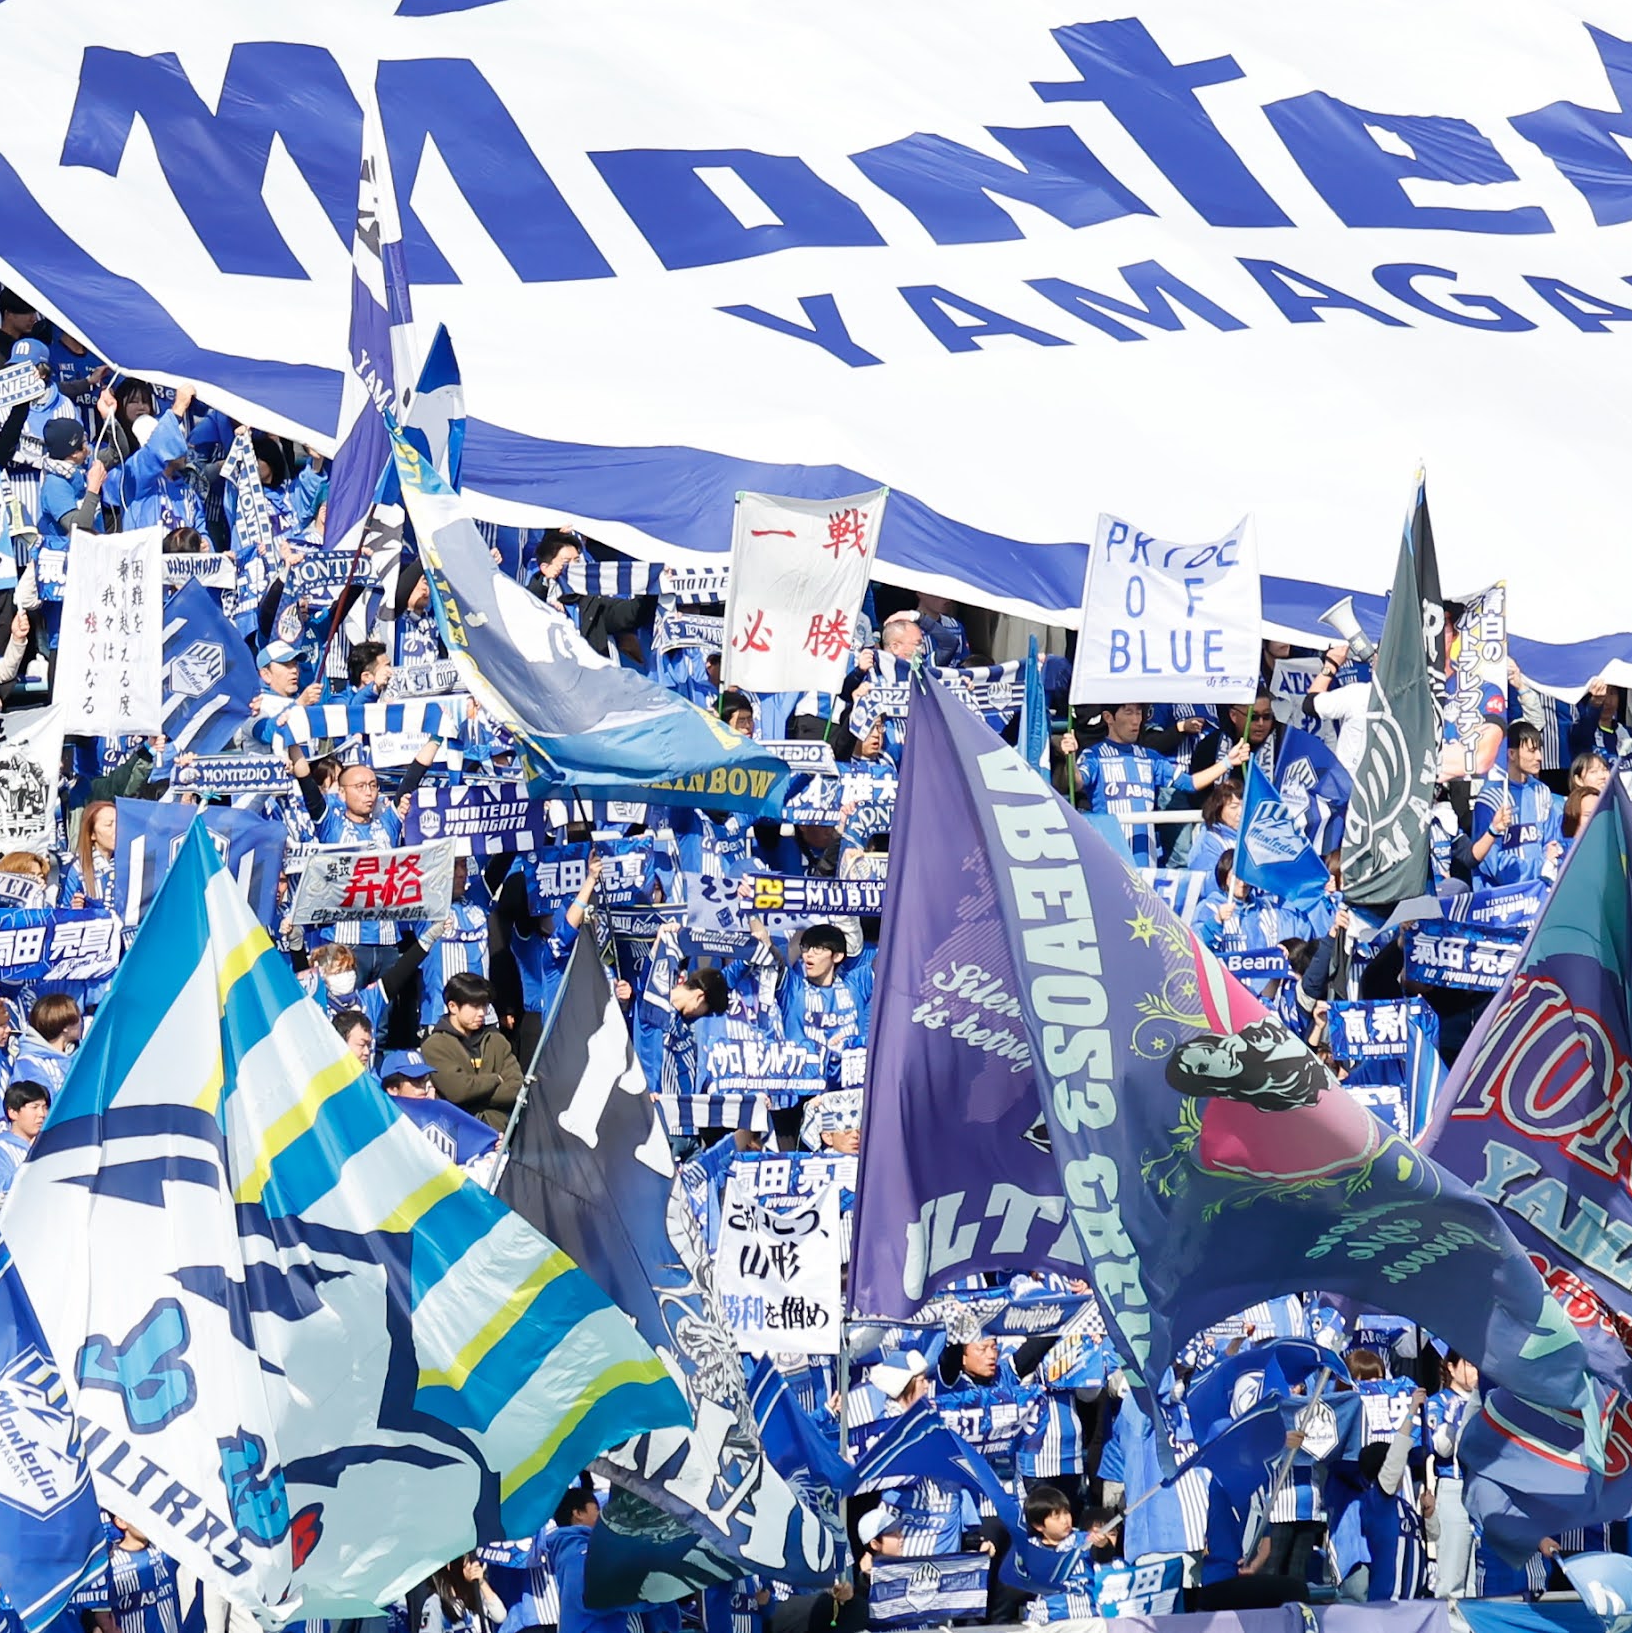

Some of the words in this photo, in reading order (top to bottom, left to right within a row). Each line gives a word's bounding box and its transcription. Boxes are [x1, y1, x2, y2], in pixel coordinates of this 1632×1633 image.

[1127, 575, 1205, 618] OF
[732, 609, 850, 660] 必勝
[1110, 629, 1225, 673] BLUE
[203, 768, 270, 782] MONTEDIO
[445, 818, 527, 836] YAMAGATA
[446, 804, 527, 820] MONTEDIO
[341, 859, 423, 908] 昇格
[739, 1245, 801, 1281] 山形
